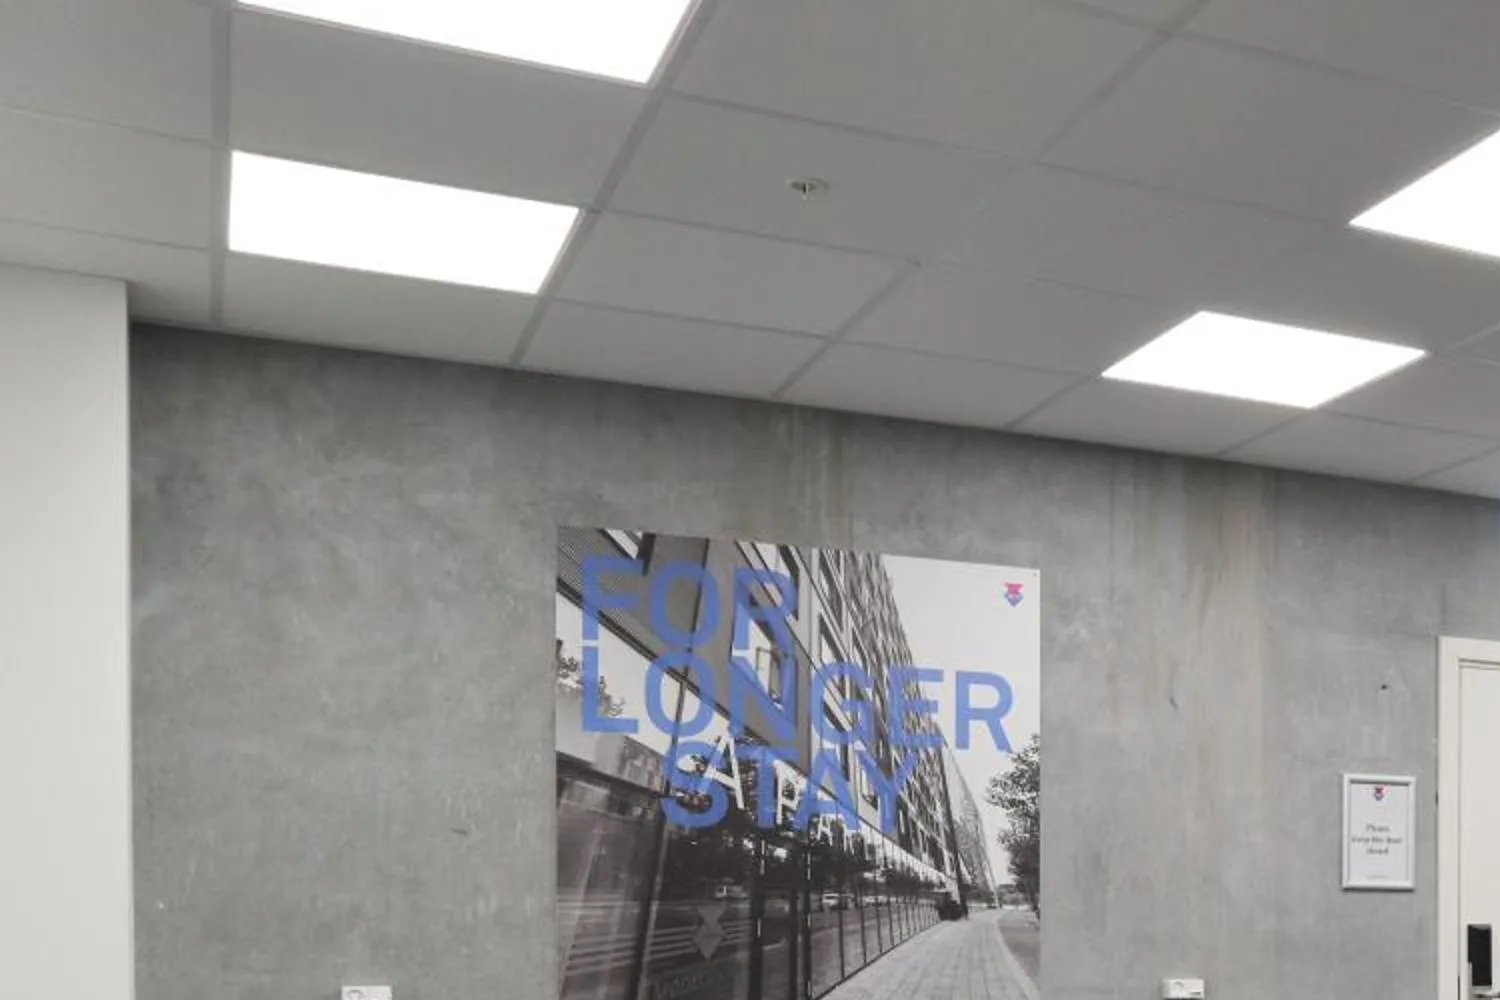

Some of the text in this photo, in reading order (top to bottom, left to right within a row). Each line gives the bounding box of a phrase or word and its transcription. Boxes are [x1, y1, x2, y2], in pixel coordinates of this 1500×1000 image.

[580, 553, 799, 652] FOR
[581, 646, 1014, 752] LONGER
[661, 741, 918, 833] STAY
